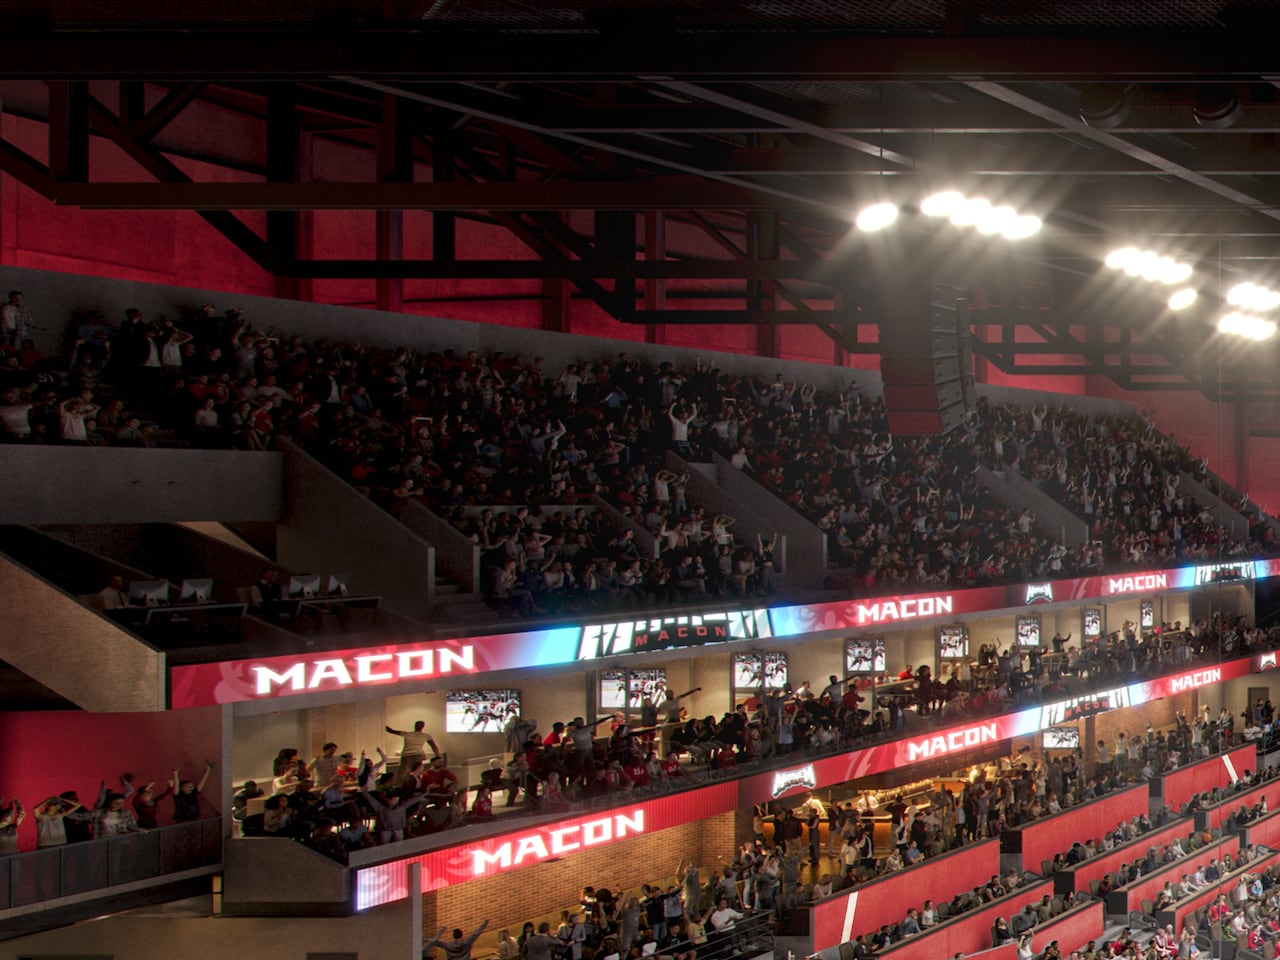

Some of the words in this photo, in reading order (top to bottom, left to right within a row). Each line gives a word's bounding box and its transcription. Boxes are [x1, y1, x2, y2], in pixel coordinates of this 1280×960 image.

[1109, 573, 1167, 594] MACON
[857, 595, 953, 624] MACON
[635, 626, 727, 647] MACON
[252, 645, 475, 695] MACON
[1171, 667, 1221, 693] MACON
[1064, 700, 1111, 718] MACON
[908, 722, 997, 762] MACON
[471, 808, 645, 876] MACON
